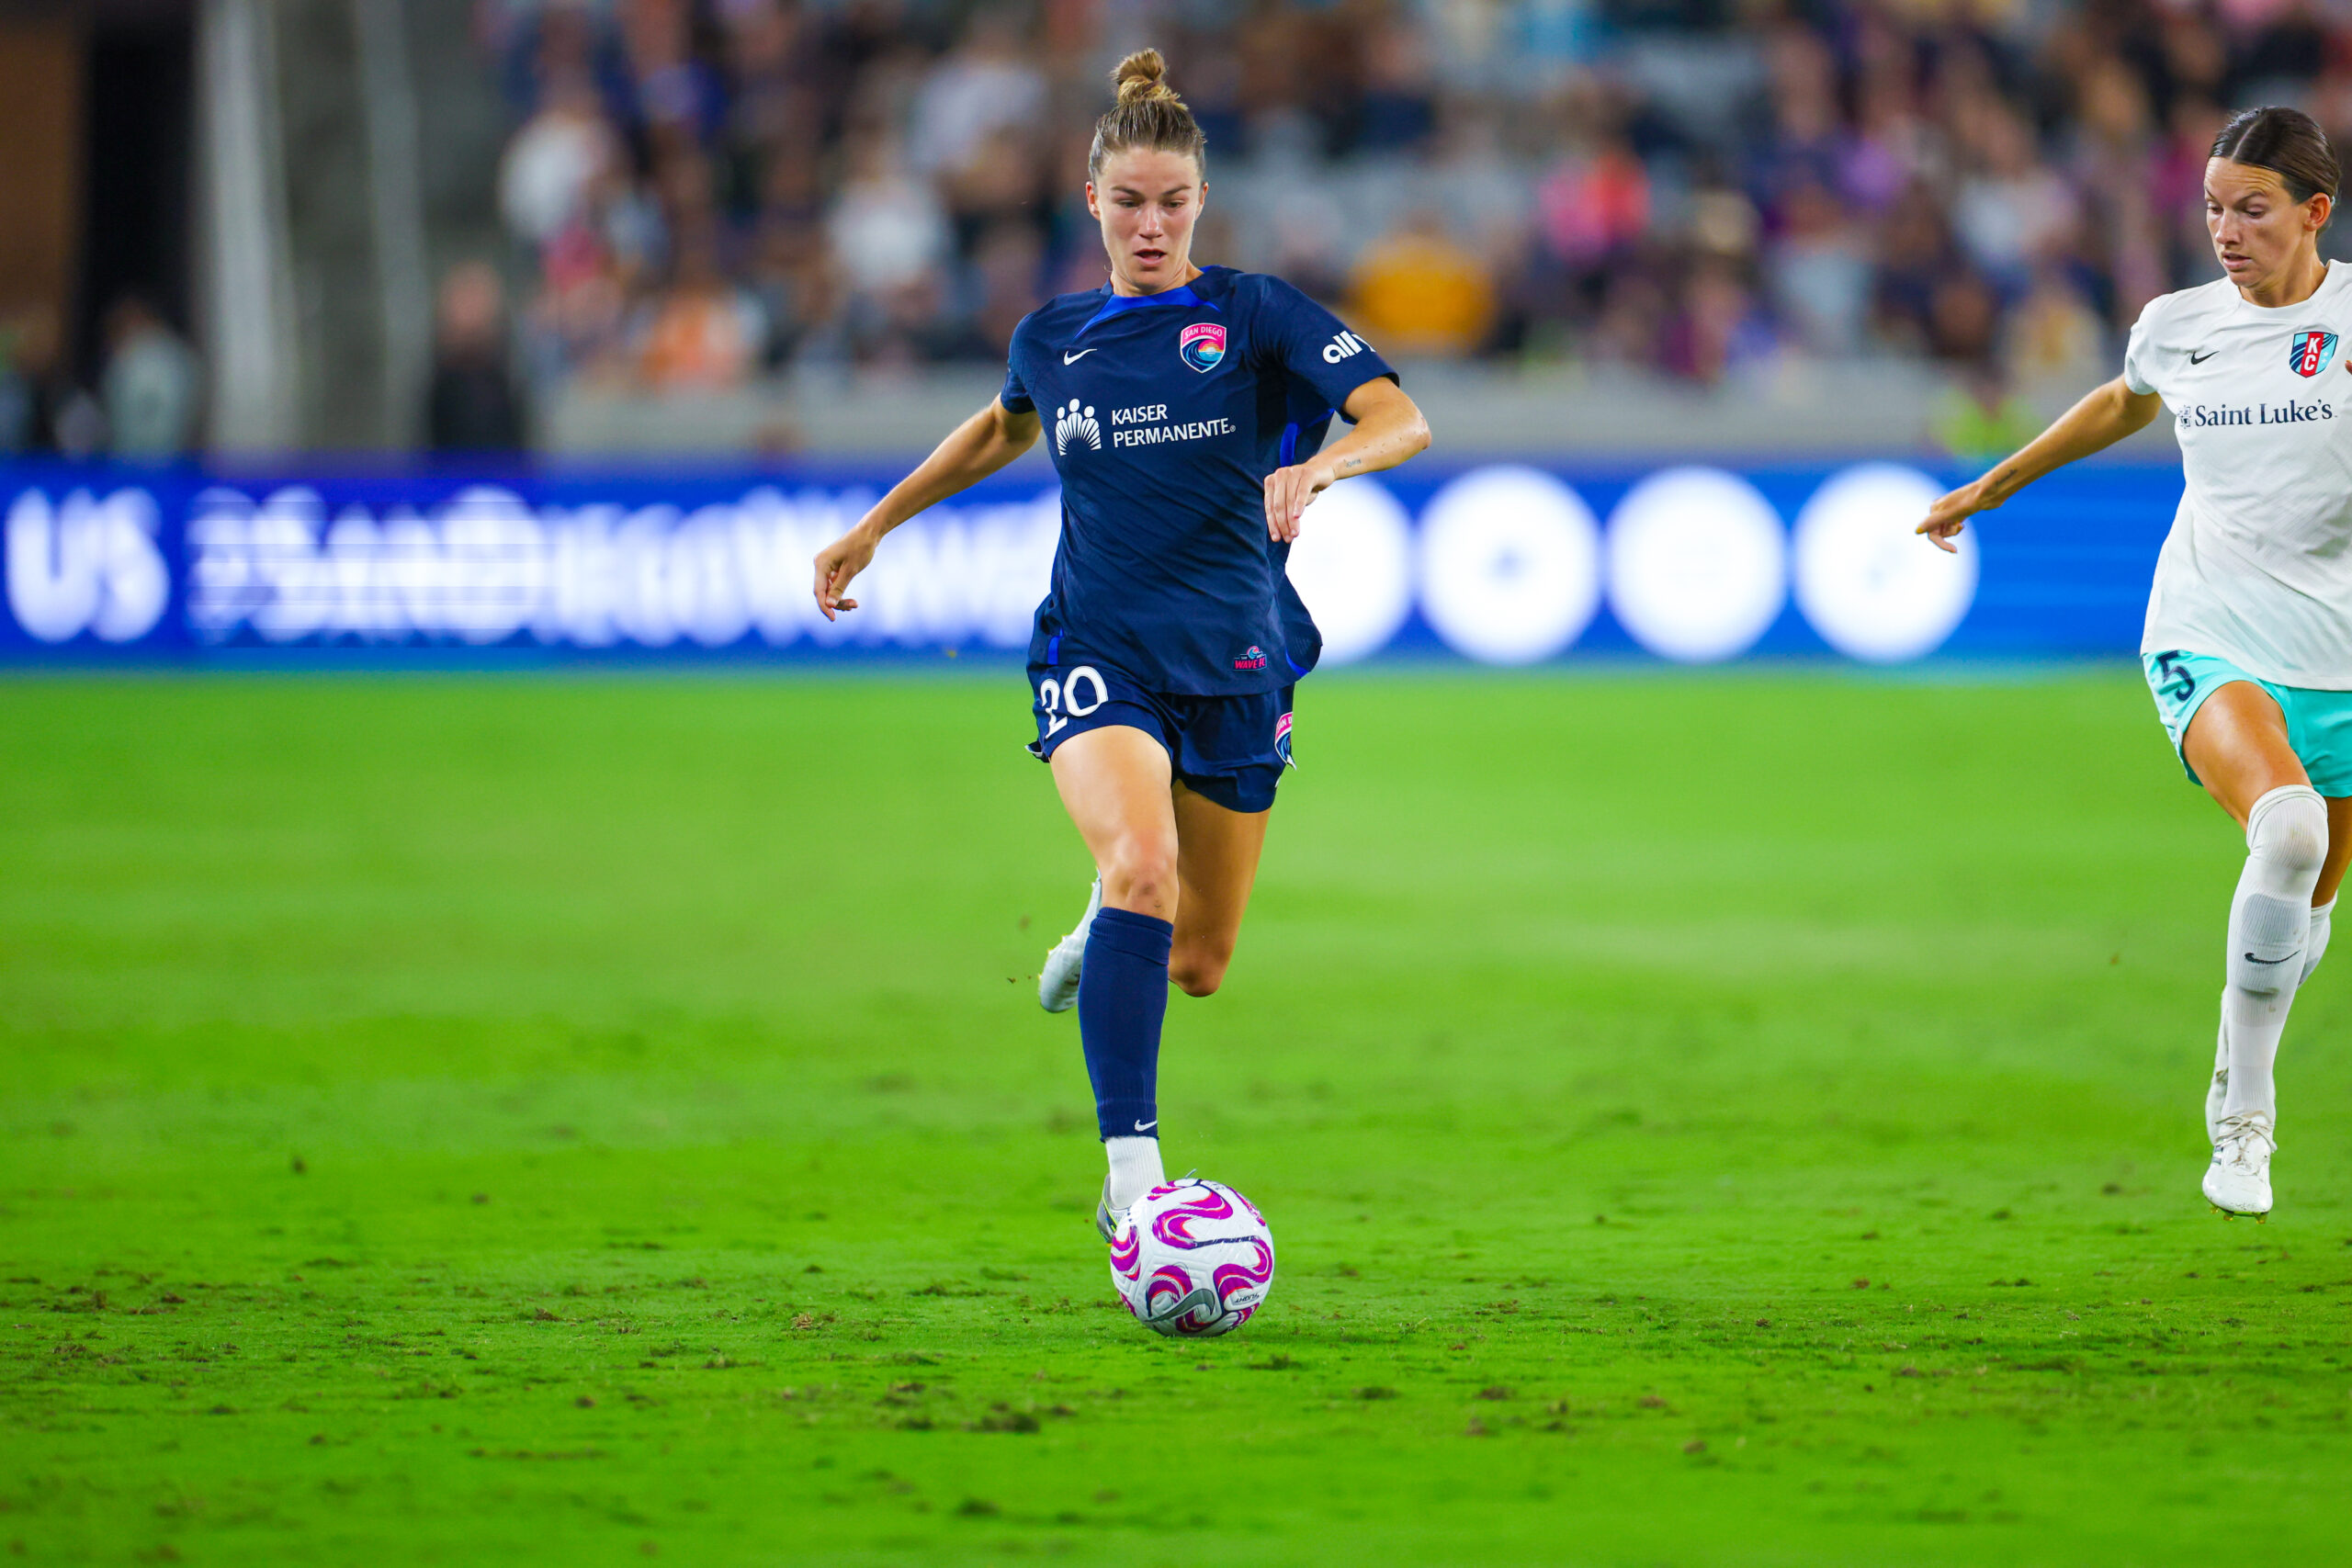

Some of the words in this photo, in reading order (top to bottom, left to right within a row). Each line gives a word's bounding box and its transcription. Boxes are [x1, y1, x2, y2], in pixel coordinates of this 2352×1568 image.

[1184, 327, 1199, 339] SAN
[1200, 326, 1223, 337] DIEGO
[1112, 403, 1169, 426] KAISER
[2195, 404, 2254, 427] Saint
[2258, 399, 2334, 424] Luke's
[1234, 659, 1257, 670] WAVE
[2155, 649, 2196, 702] 5
[1040, 666, 1108, 739] 20
